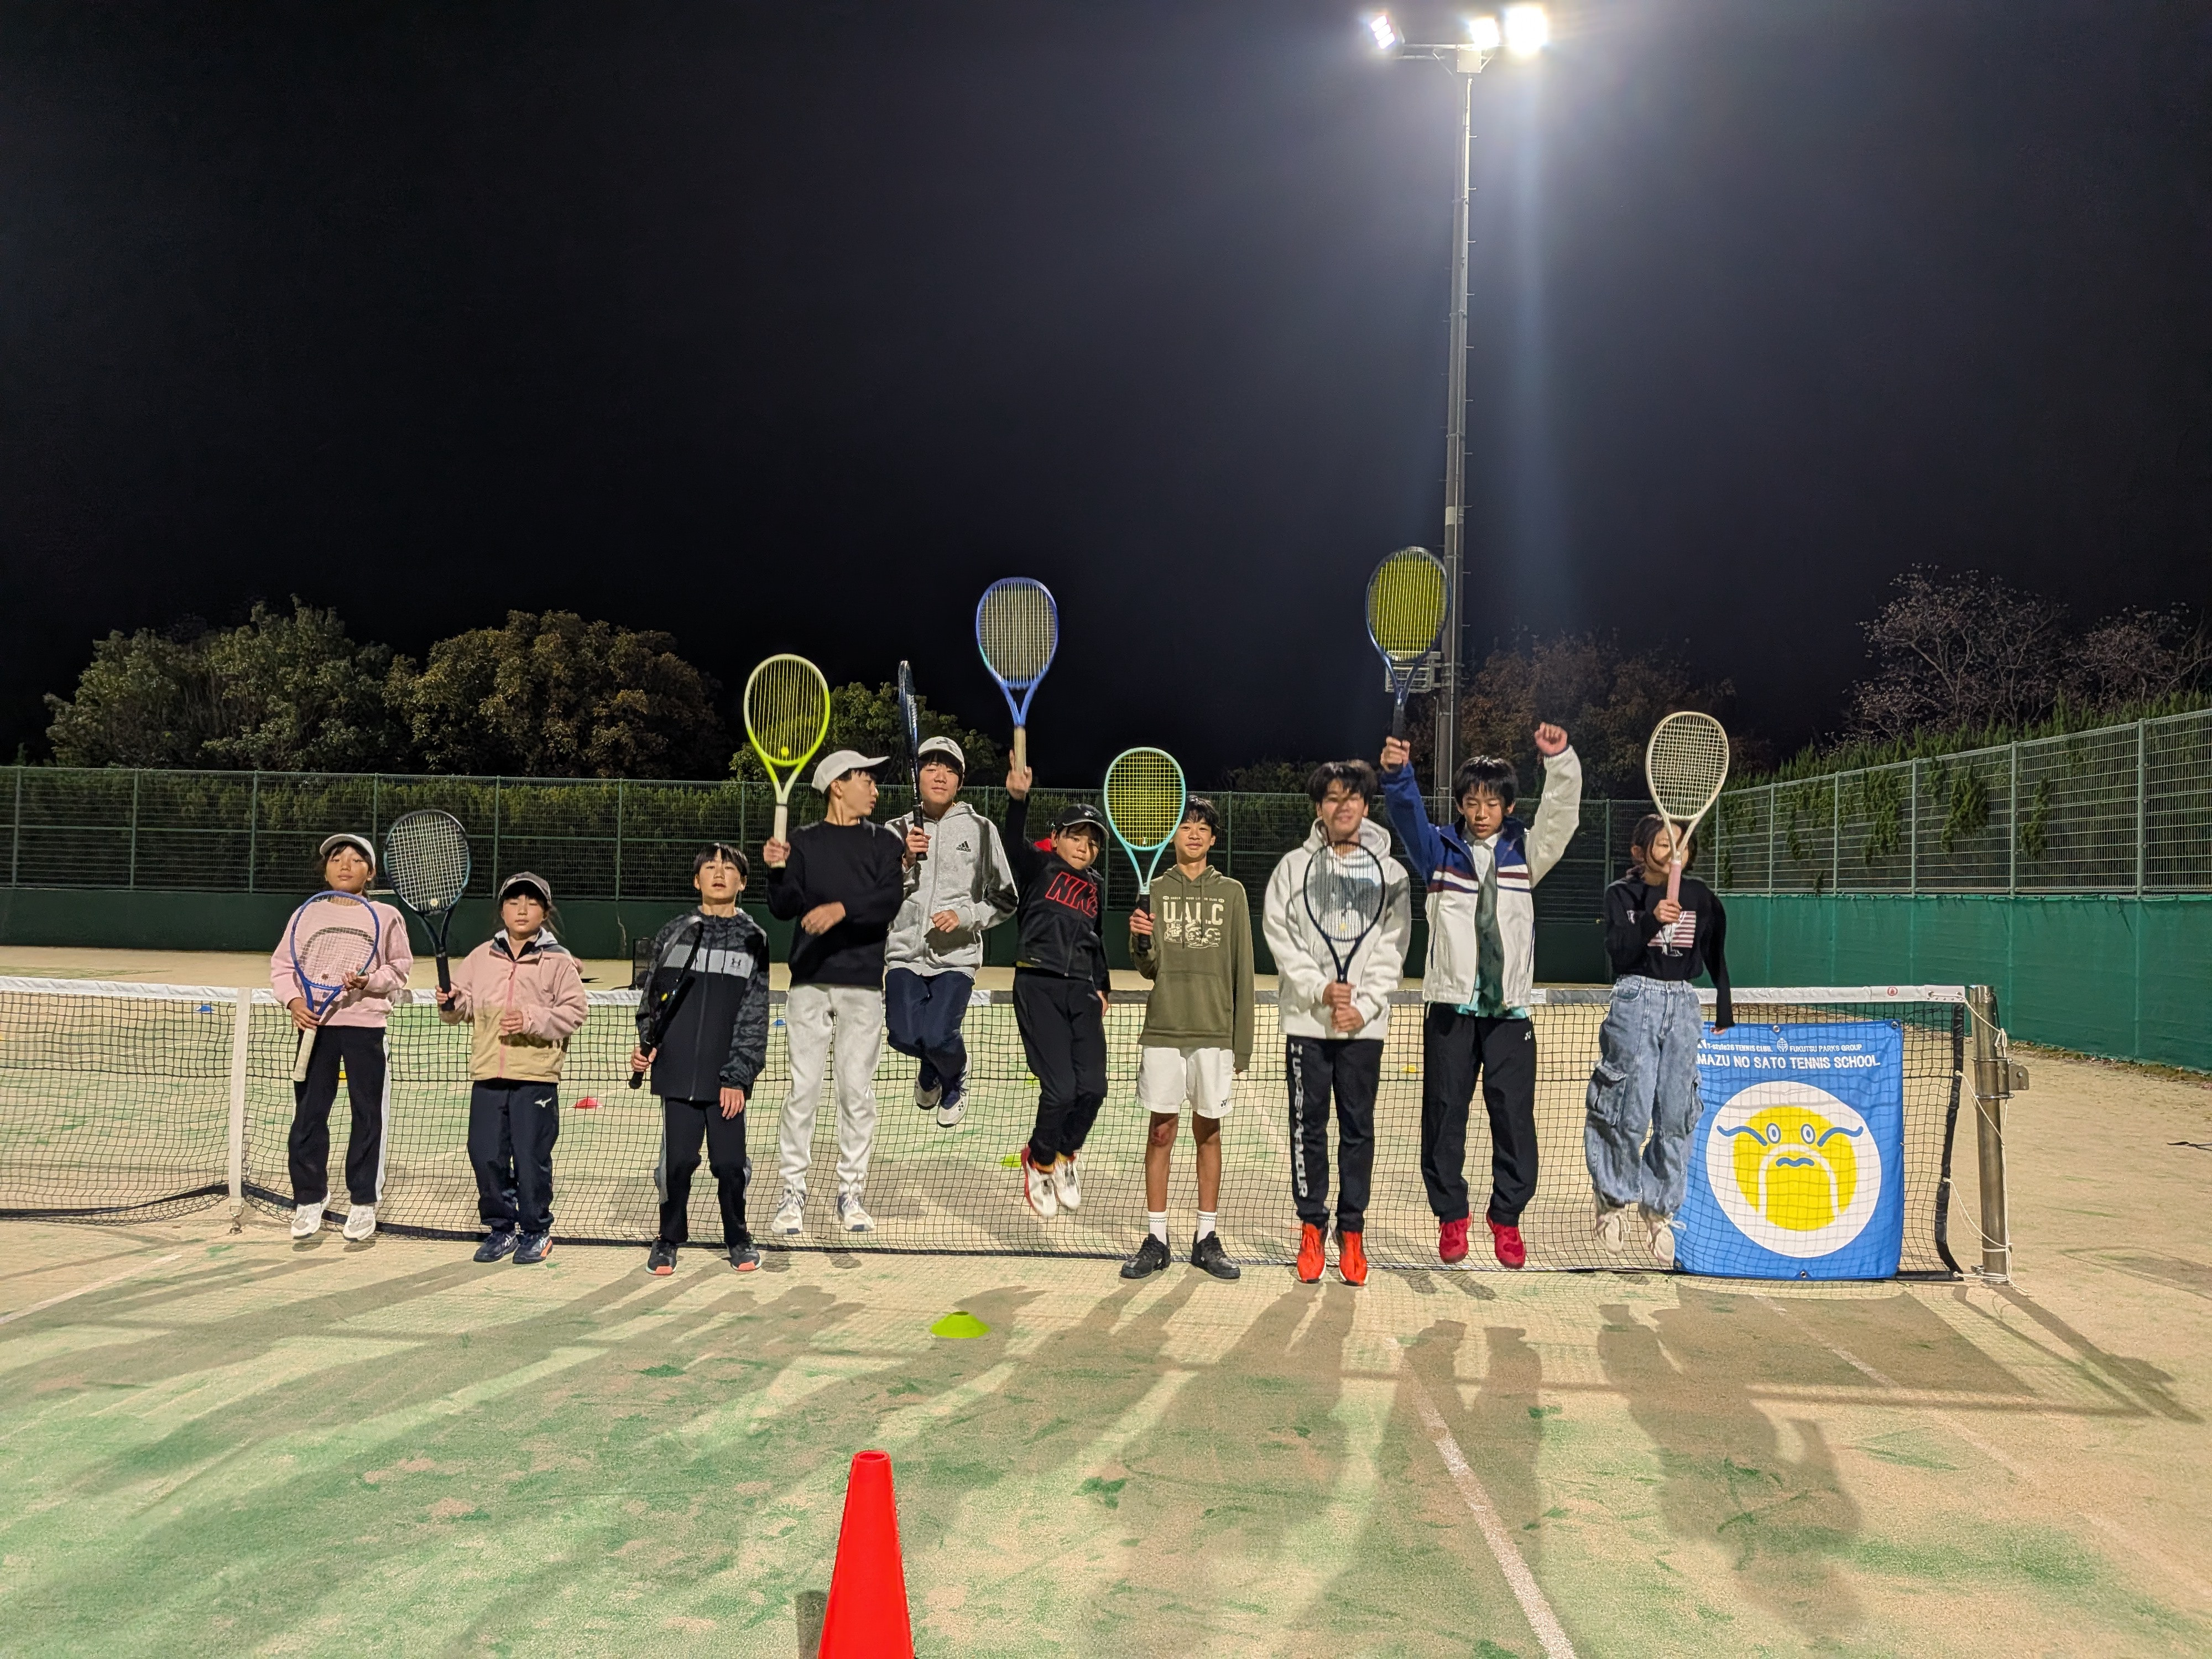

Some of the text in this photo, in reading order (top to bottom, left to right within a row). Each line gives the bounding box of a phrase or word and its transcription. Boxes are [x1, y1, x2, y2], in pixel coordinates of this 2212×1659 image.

[1696, 1052, 1881, 1070] MAZU NO SATO TENNIS SCHOOL
